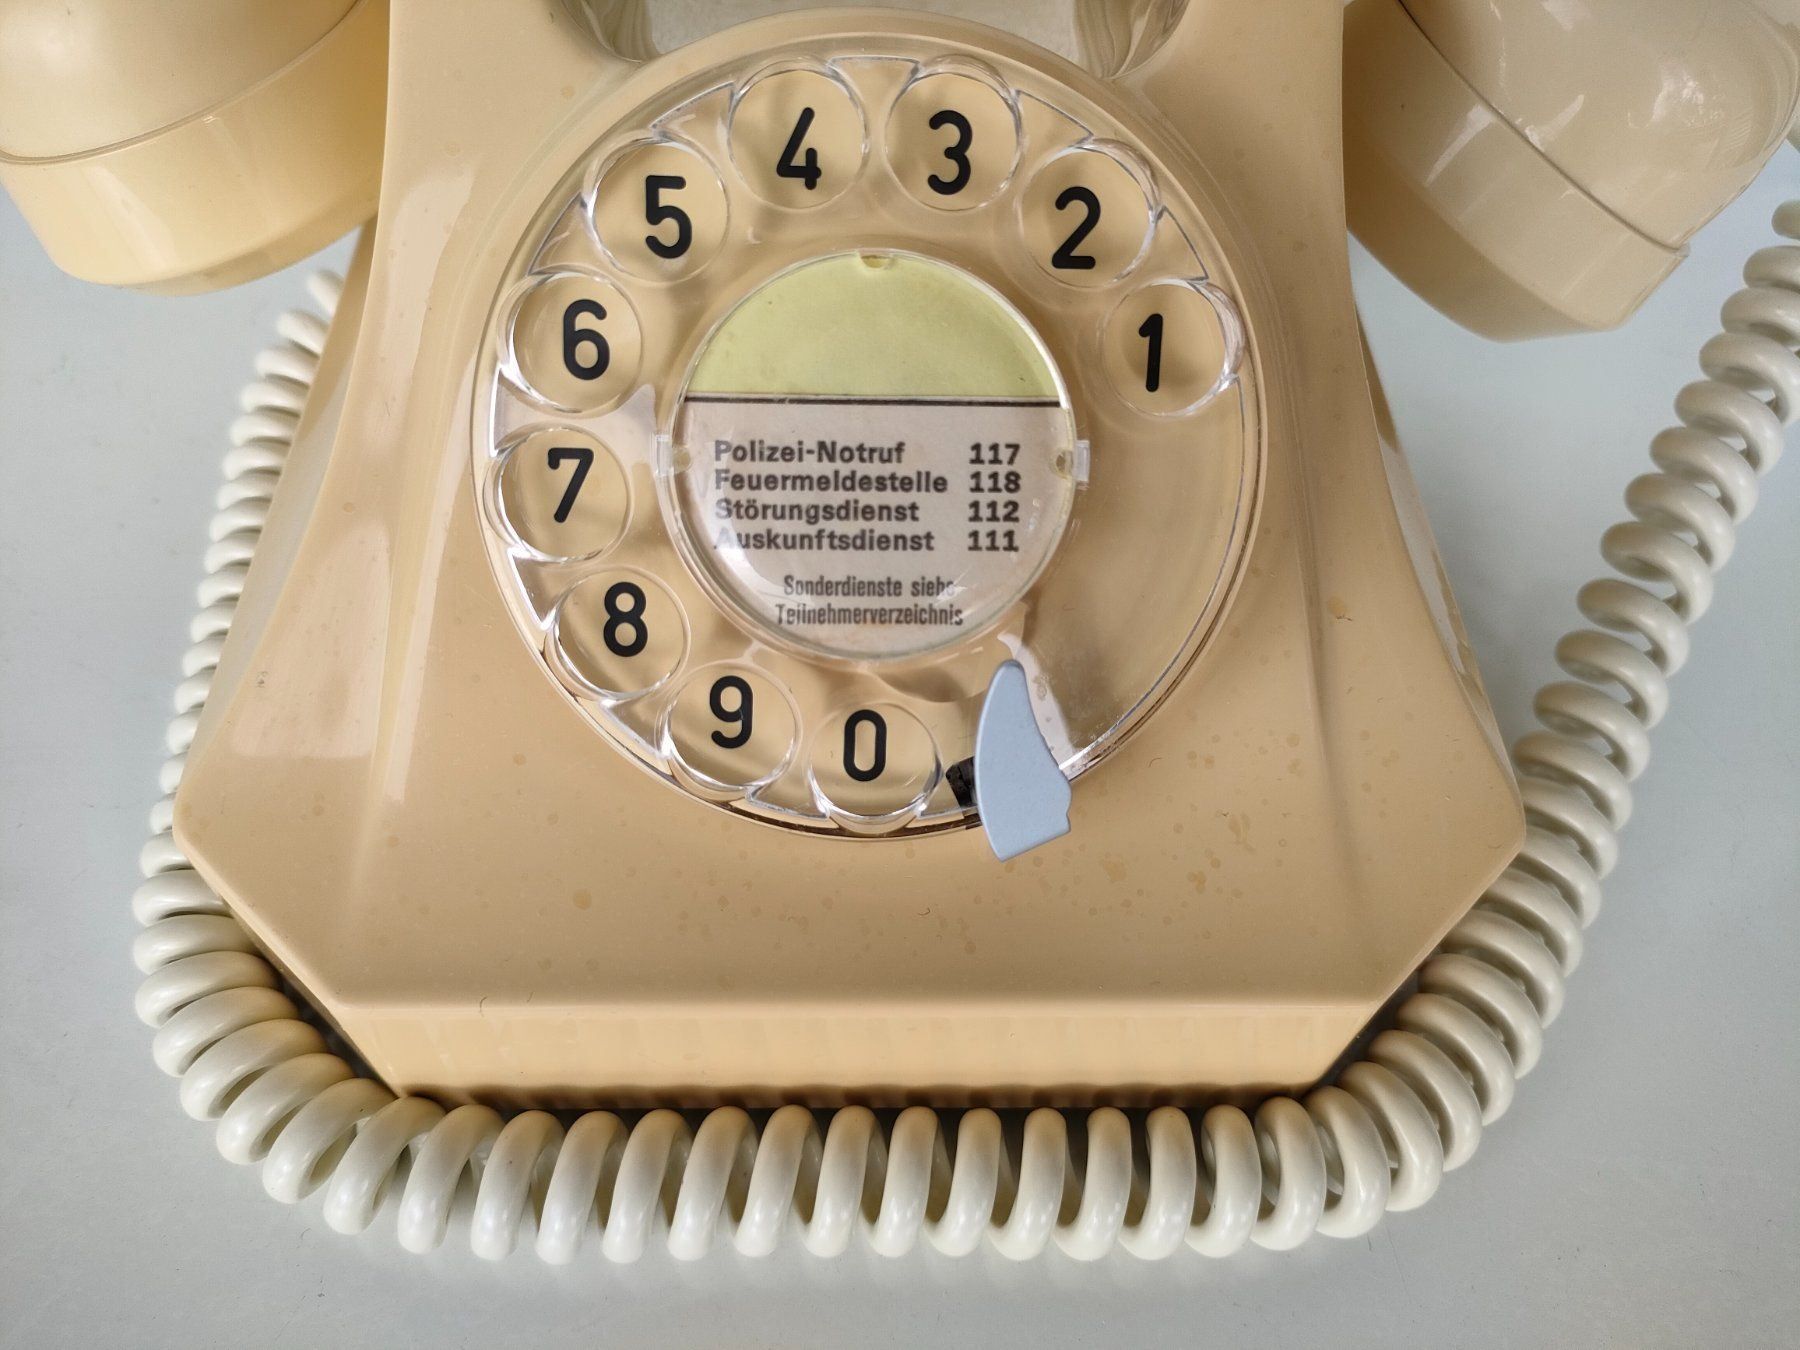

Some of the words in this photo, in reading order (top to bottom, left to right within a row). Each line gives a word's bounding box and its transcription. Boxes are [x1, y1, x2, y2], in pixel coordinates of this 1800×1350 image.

[775, 107, 822, 191] 4
[927, 109, 973, 196] 3
[645, 174, 692, 259] 5
[1051, 186, 1101, 270] 2
[563, 299, 610, 381] 6
[1138, 313, 1164, 393] 1
[547, 447, 594, 523] 7
[714, 439, 906, 464] Polizei-Notruf
[968, 442, 1021, 466] 117
[714, 468, 948, 493] Feuermeldestelle
[968, 471, 1022, 494] 118
[714, 497, 920, 526] Störungsdienst
[967, 500, 1020, 523] 112
[967, 530, 1020, 552] 111
[603, 581, 648, 658] 8
[775, 602, 964, 627] Teilnehmerverzeichnis
[783, 574, 903, 598] Sonderdienste
[709, 675, 753, 749] 9
[843, 709, 887, 783] 0
